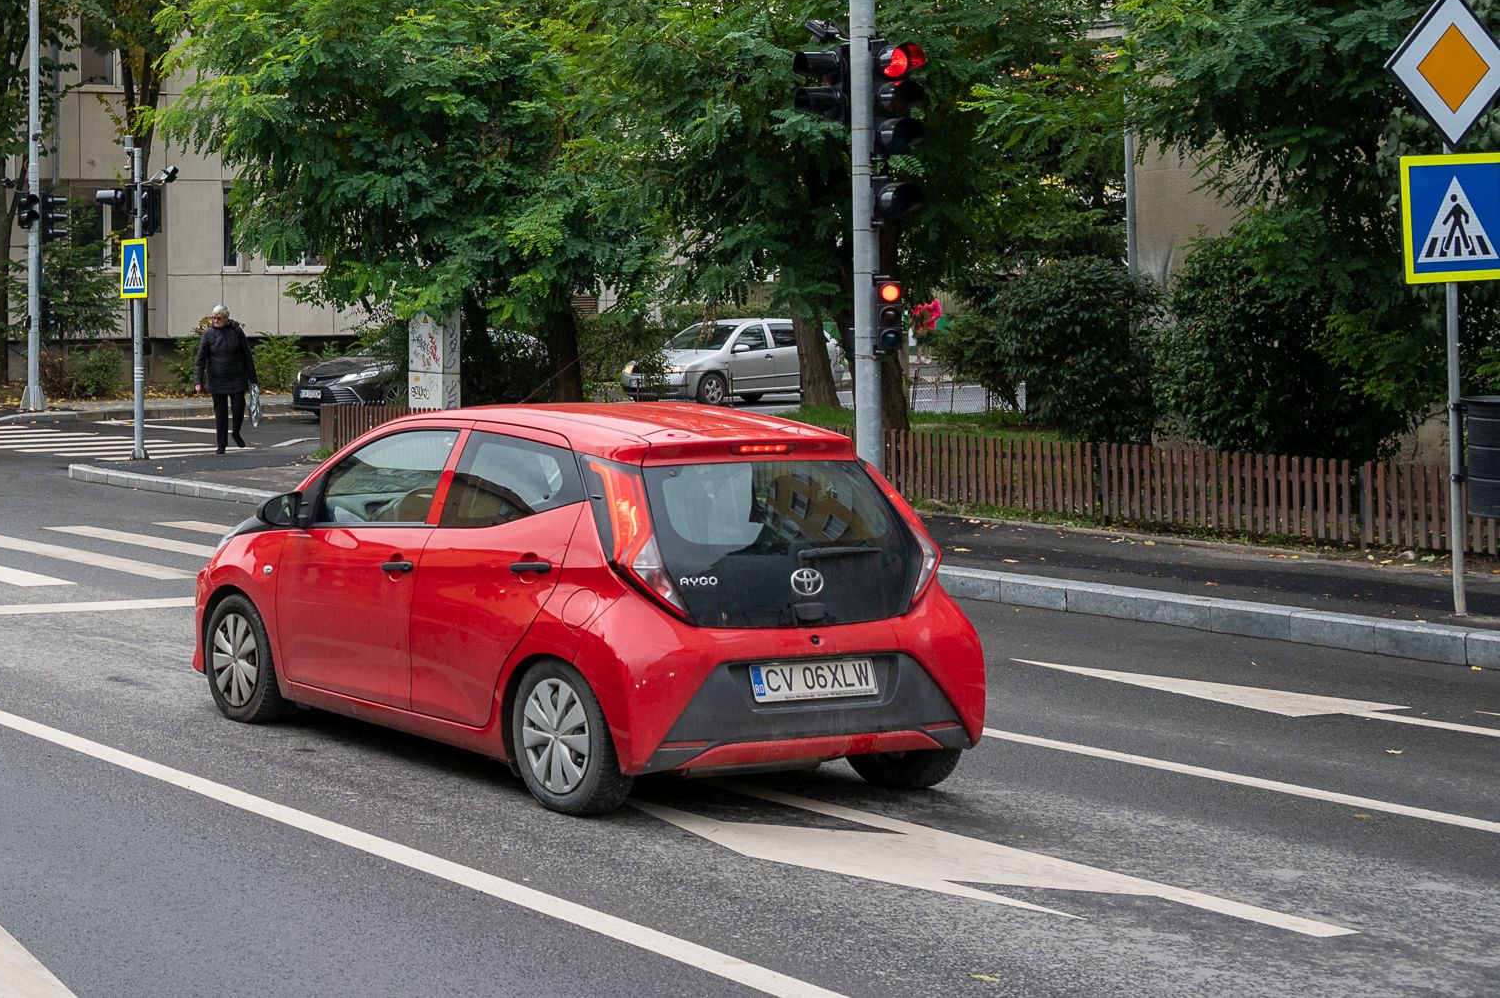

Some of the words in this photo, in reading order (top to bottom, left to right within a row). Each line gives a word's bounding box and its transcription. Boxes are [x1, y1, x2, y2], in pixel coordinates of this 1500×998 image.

[679, 576, 718, 586] AYGO
[765, 667, 793, 692] CV
[802, 662, 870, 690] 06XLW
[755, 684, 765, 694] RO
